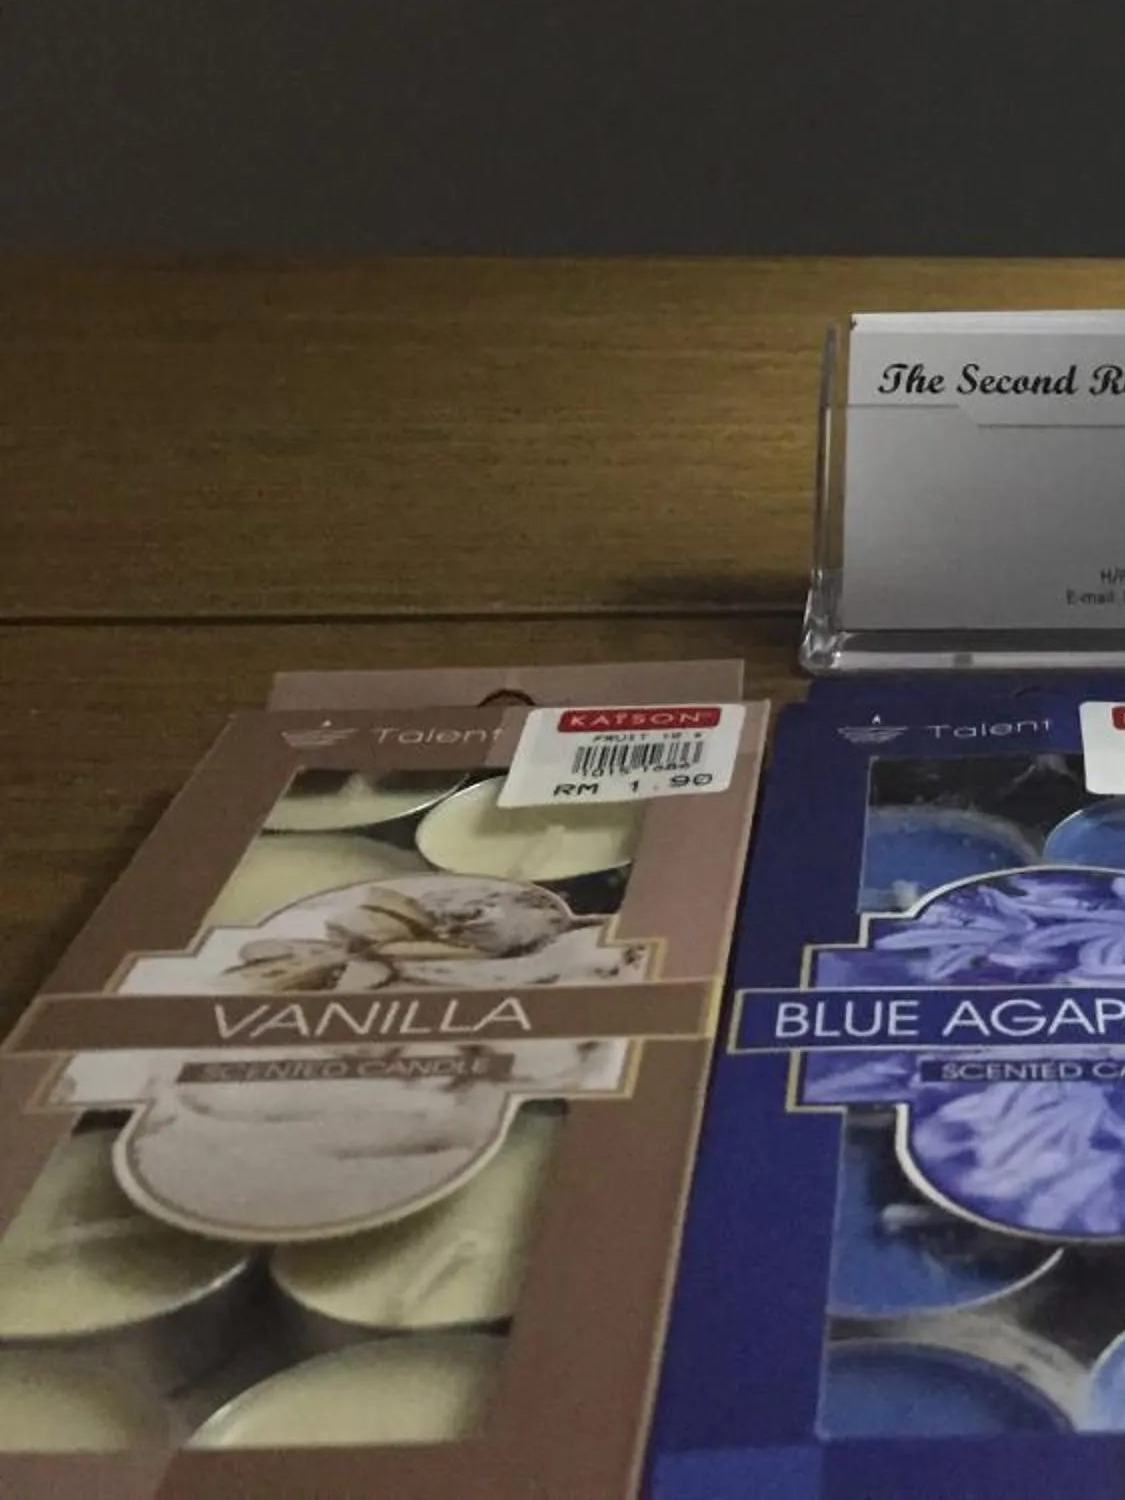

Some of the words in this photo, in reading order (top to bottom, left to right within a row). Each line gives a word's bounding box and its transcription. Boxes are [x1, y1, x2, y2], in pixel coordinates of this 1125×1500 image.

[878, 363, 945, 395] The
[956, 363, 1079, 395] Second
[373, 724, 507, 744] Talent
[927, 718, 1054, 741] Talent
[553, 784, 600, 797] RM
[213, 996, 533, 1038] VANILLA
[775, 1001, 920, 1038] BLUE
[201, 1059, 350, 1078] SCENTED
[356, 1057, 489, 1077] CANDLE
[941, 1061, 1082, 1080] SCENTED
